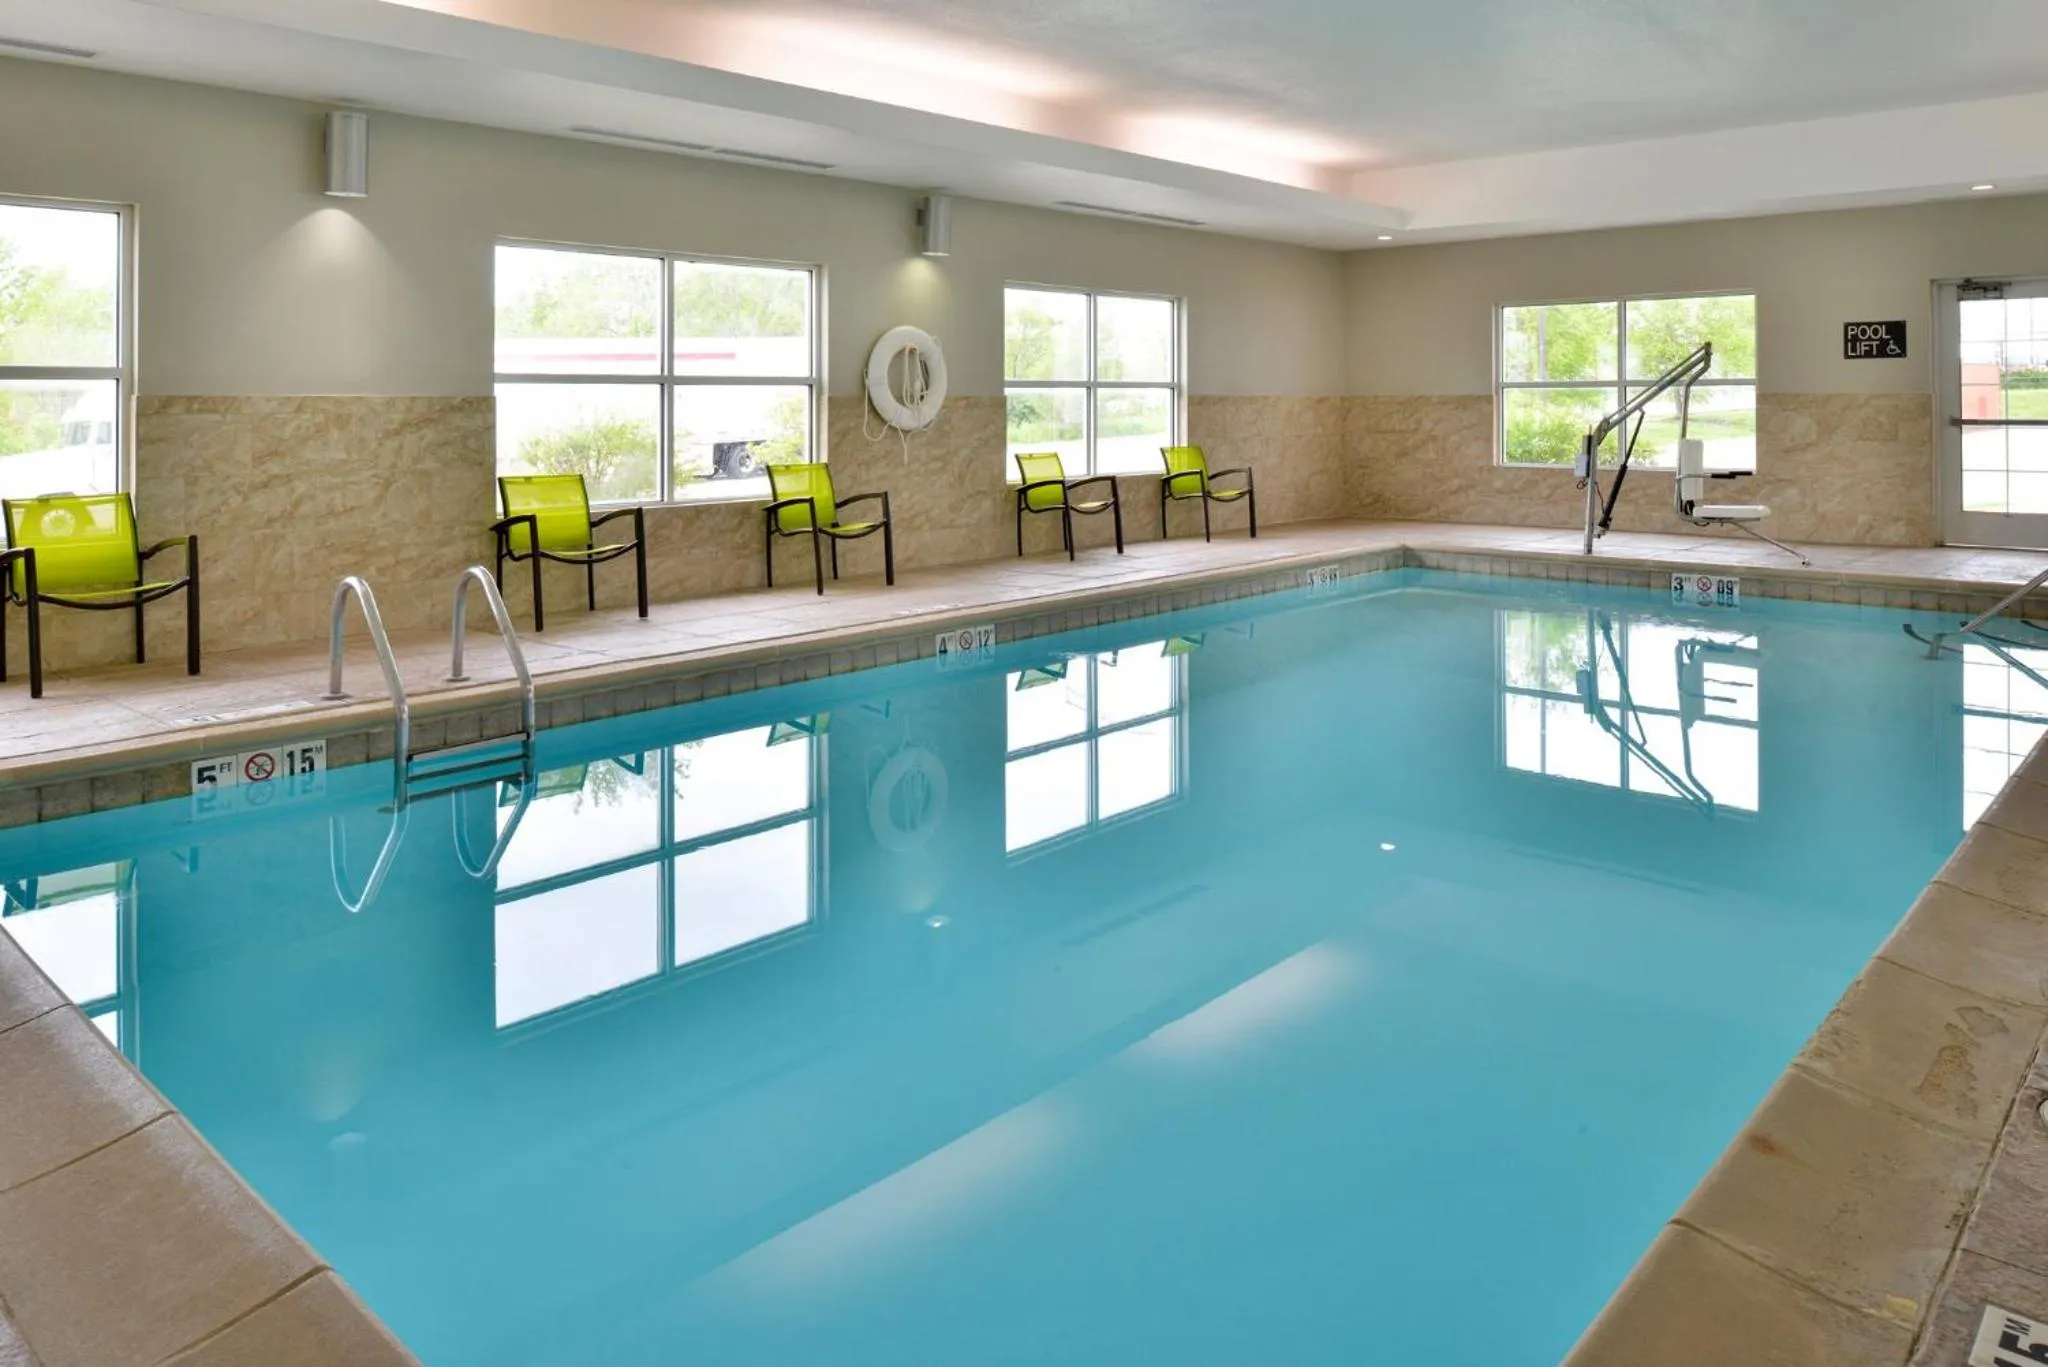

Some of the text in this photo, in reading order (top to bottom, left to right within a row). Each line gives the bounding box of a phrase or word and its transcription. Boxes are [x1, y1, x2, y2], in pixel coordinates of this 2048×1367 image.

[1847, 324, 1891, 340] POOL
[1847, 341, 1881, 356] LIFT
[1673, 576, 1684, 591] 3
[938, 637, 948, 654] 4
[197, 765, 218, 785] 5
